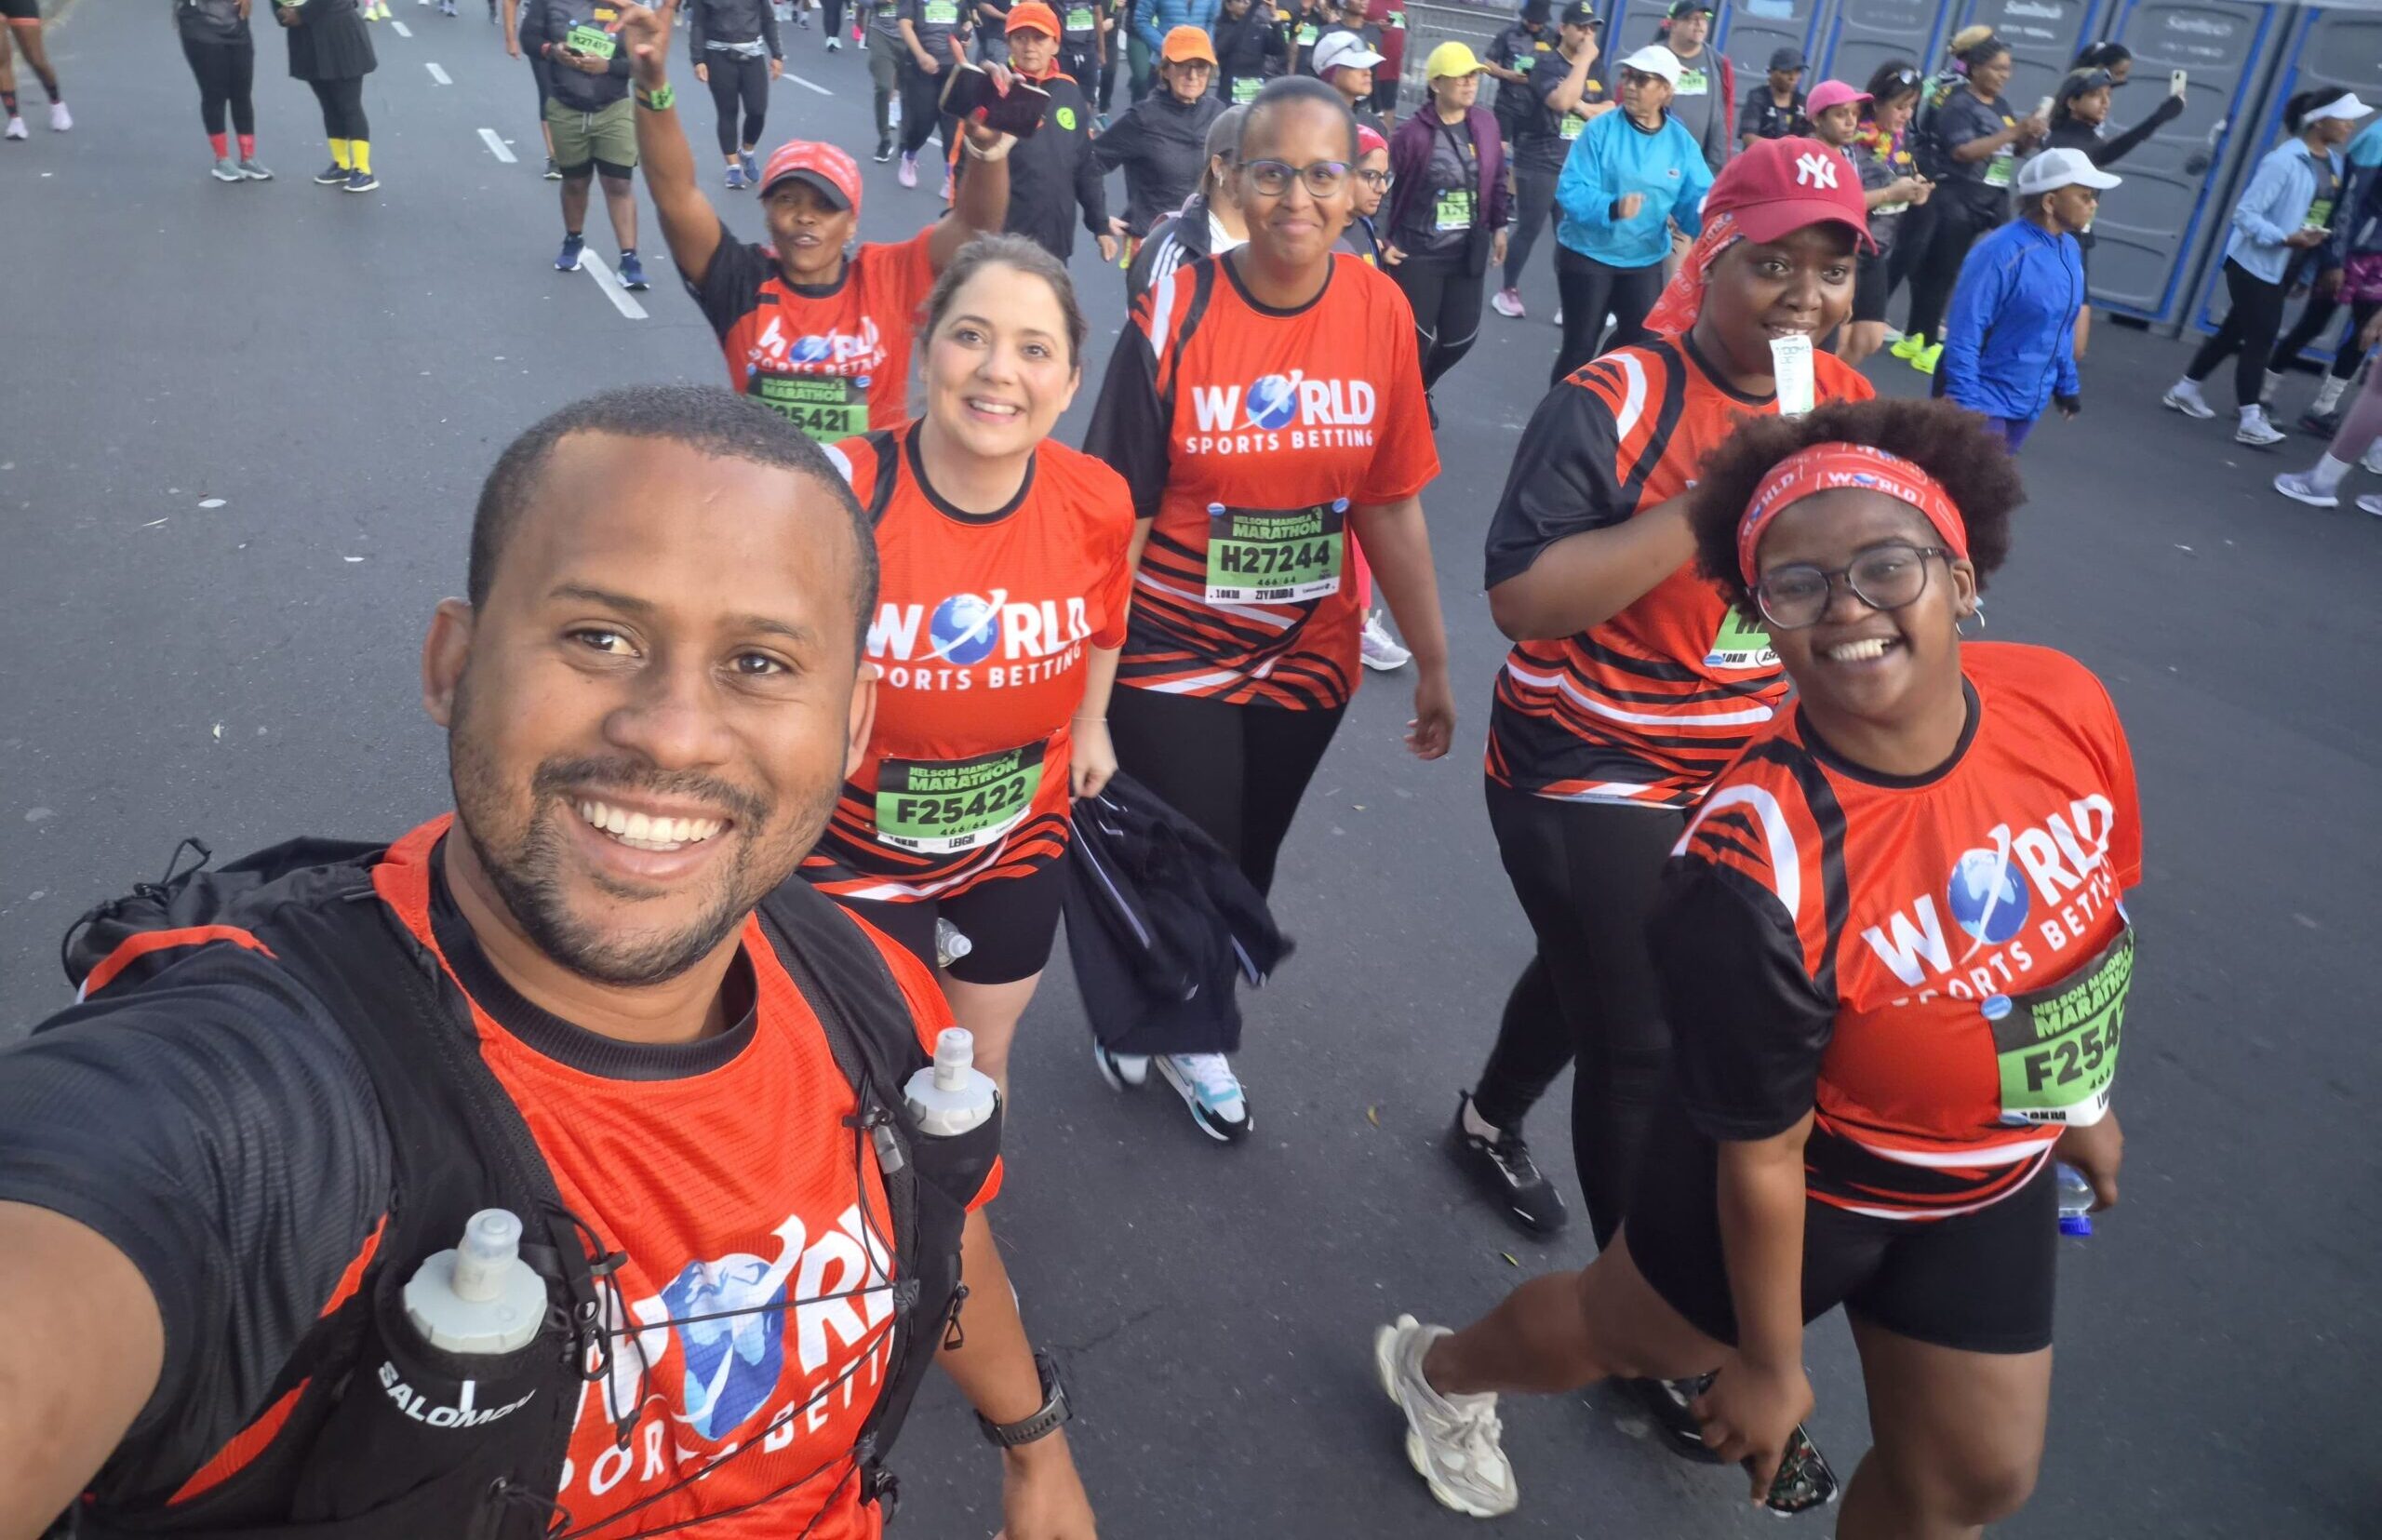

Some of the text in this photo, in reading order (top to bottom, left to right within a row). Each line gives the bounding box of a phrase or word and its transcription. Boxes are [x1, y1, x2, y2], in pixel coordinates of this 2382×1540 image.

[1192, 368, 1376, 432] WORLD
[765, 403, 850, 432] 5421
[1185, 428, 1373, 454] SPORTS BETTING
[1827, 471, 1917, 502] WORLD
[1233, 519, 1322, 540] MARATHON
[1221, 540, 1330, 573] H27244
[871, 641, 1081, 690] ORTS BETTING
[908, 758, 1019, 792] MARATHON
[909, 765, 957, 778] NELSON
[896, 776, 1027, 825] F25422
[1860, 793, 2114, 987] WORLD
[1892, 940, 2033, 1006] ORTS
[2031, 984, 2087, 1017] NELSON
[379, 1360, 537, 1428] SALOMON
